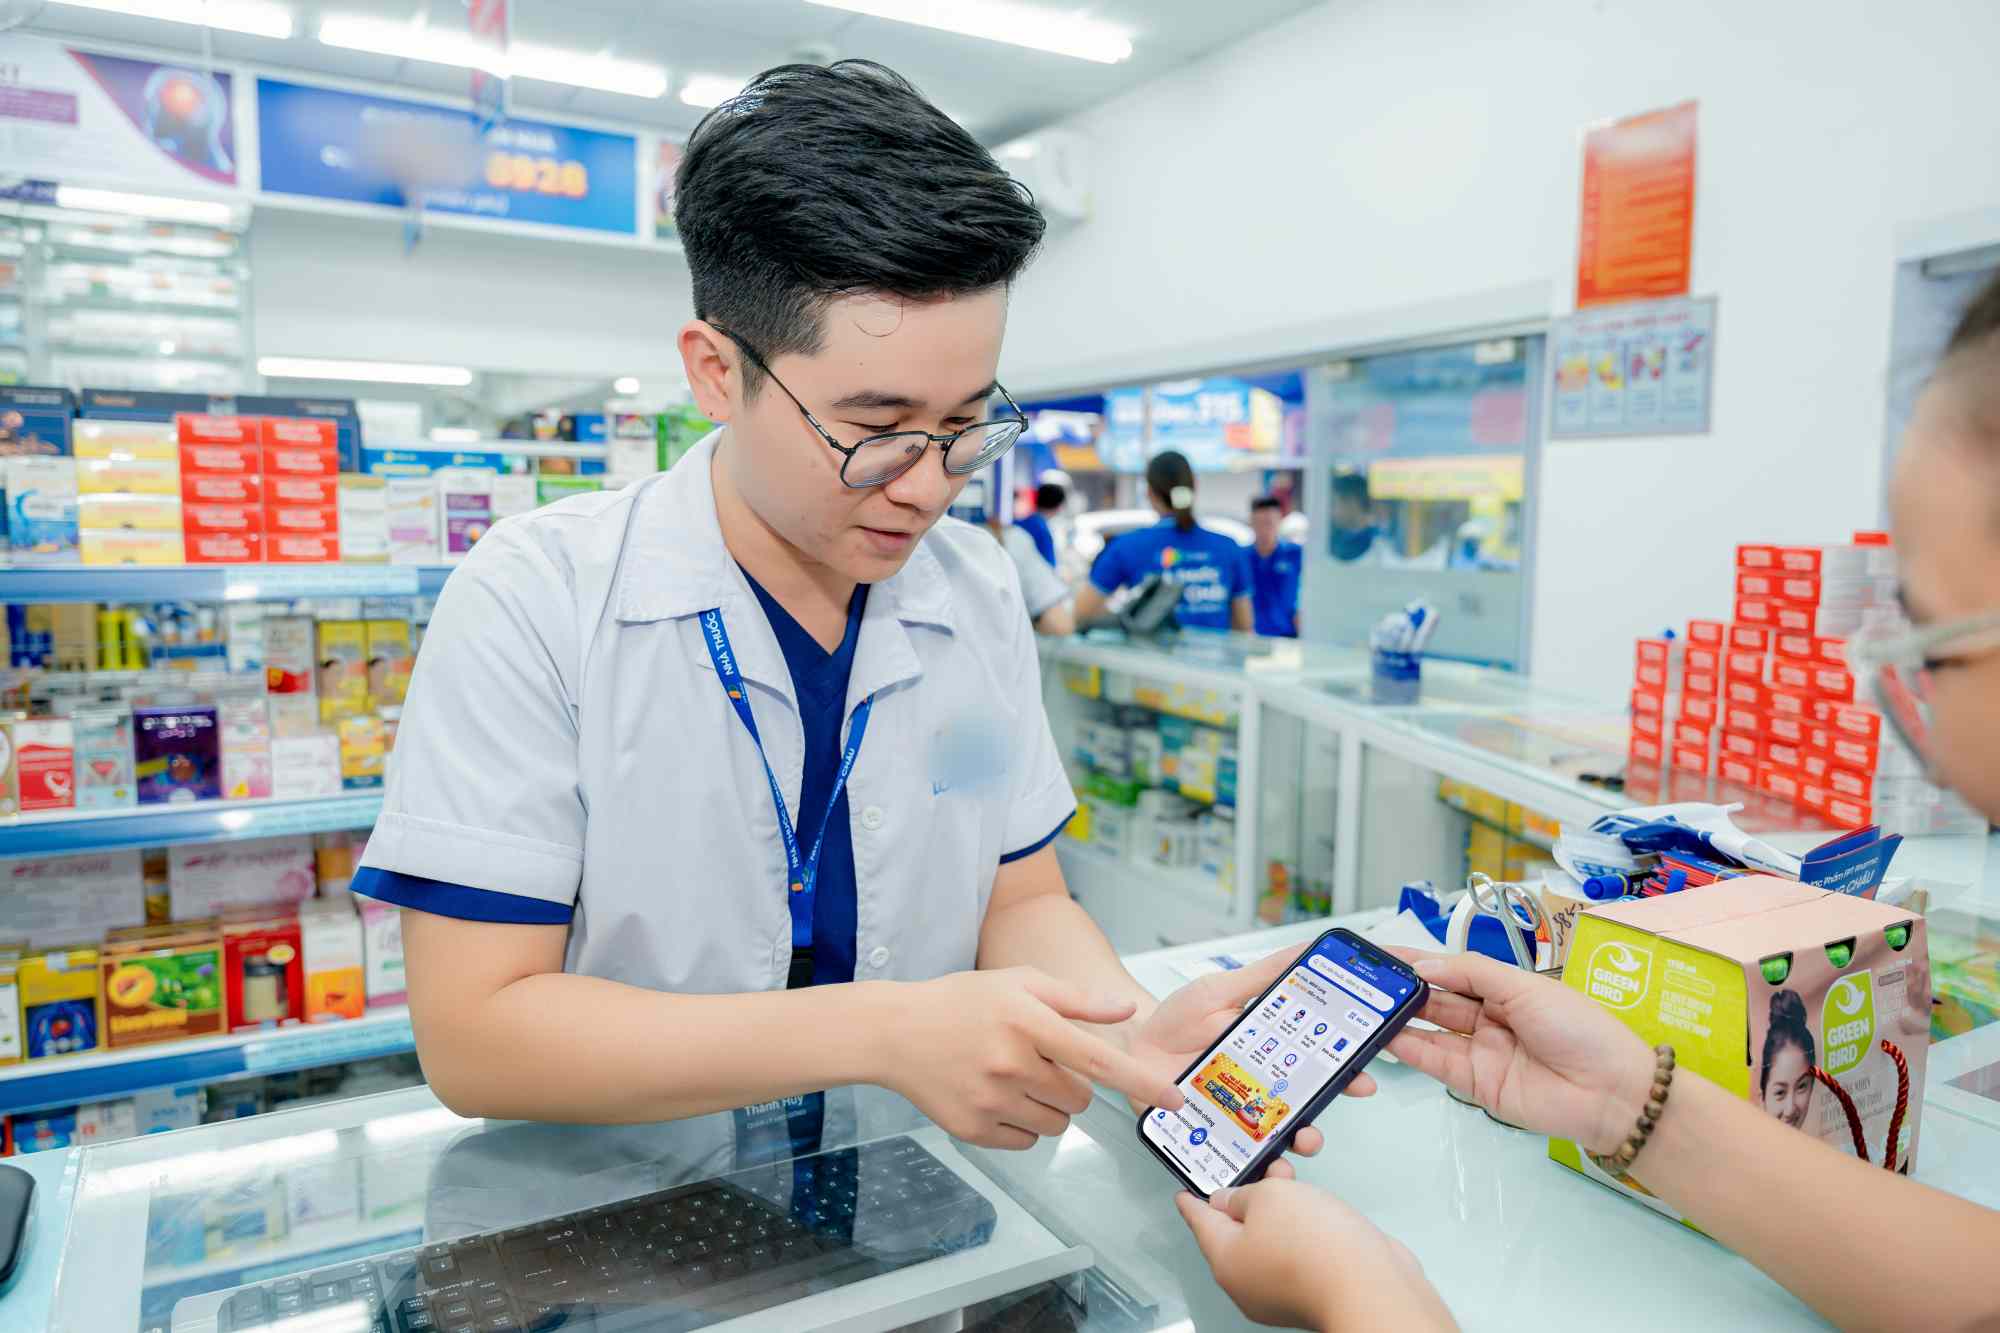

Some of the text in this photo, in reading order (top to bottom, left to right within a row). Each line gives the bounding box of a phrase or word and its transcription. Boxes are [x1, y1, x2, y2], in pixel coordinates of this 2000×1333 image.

[1591, 982, 1624, 1003] BIRD
[1593, 968, 1641, 993] GREEN
[1826, 1017, 1870, 1047] GREEN
[1828, 1044, 1859, 1071] BIRD
